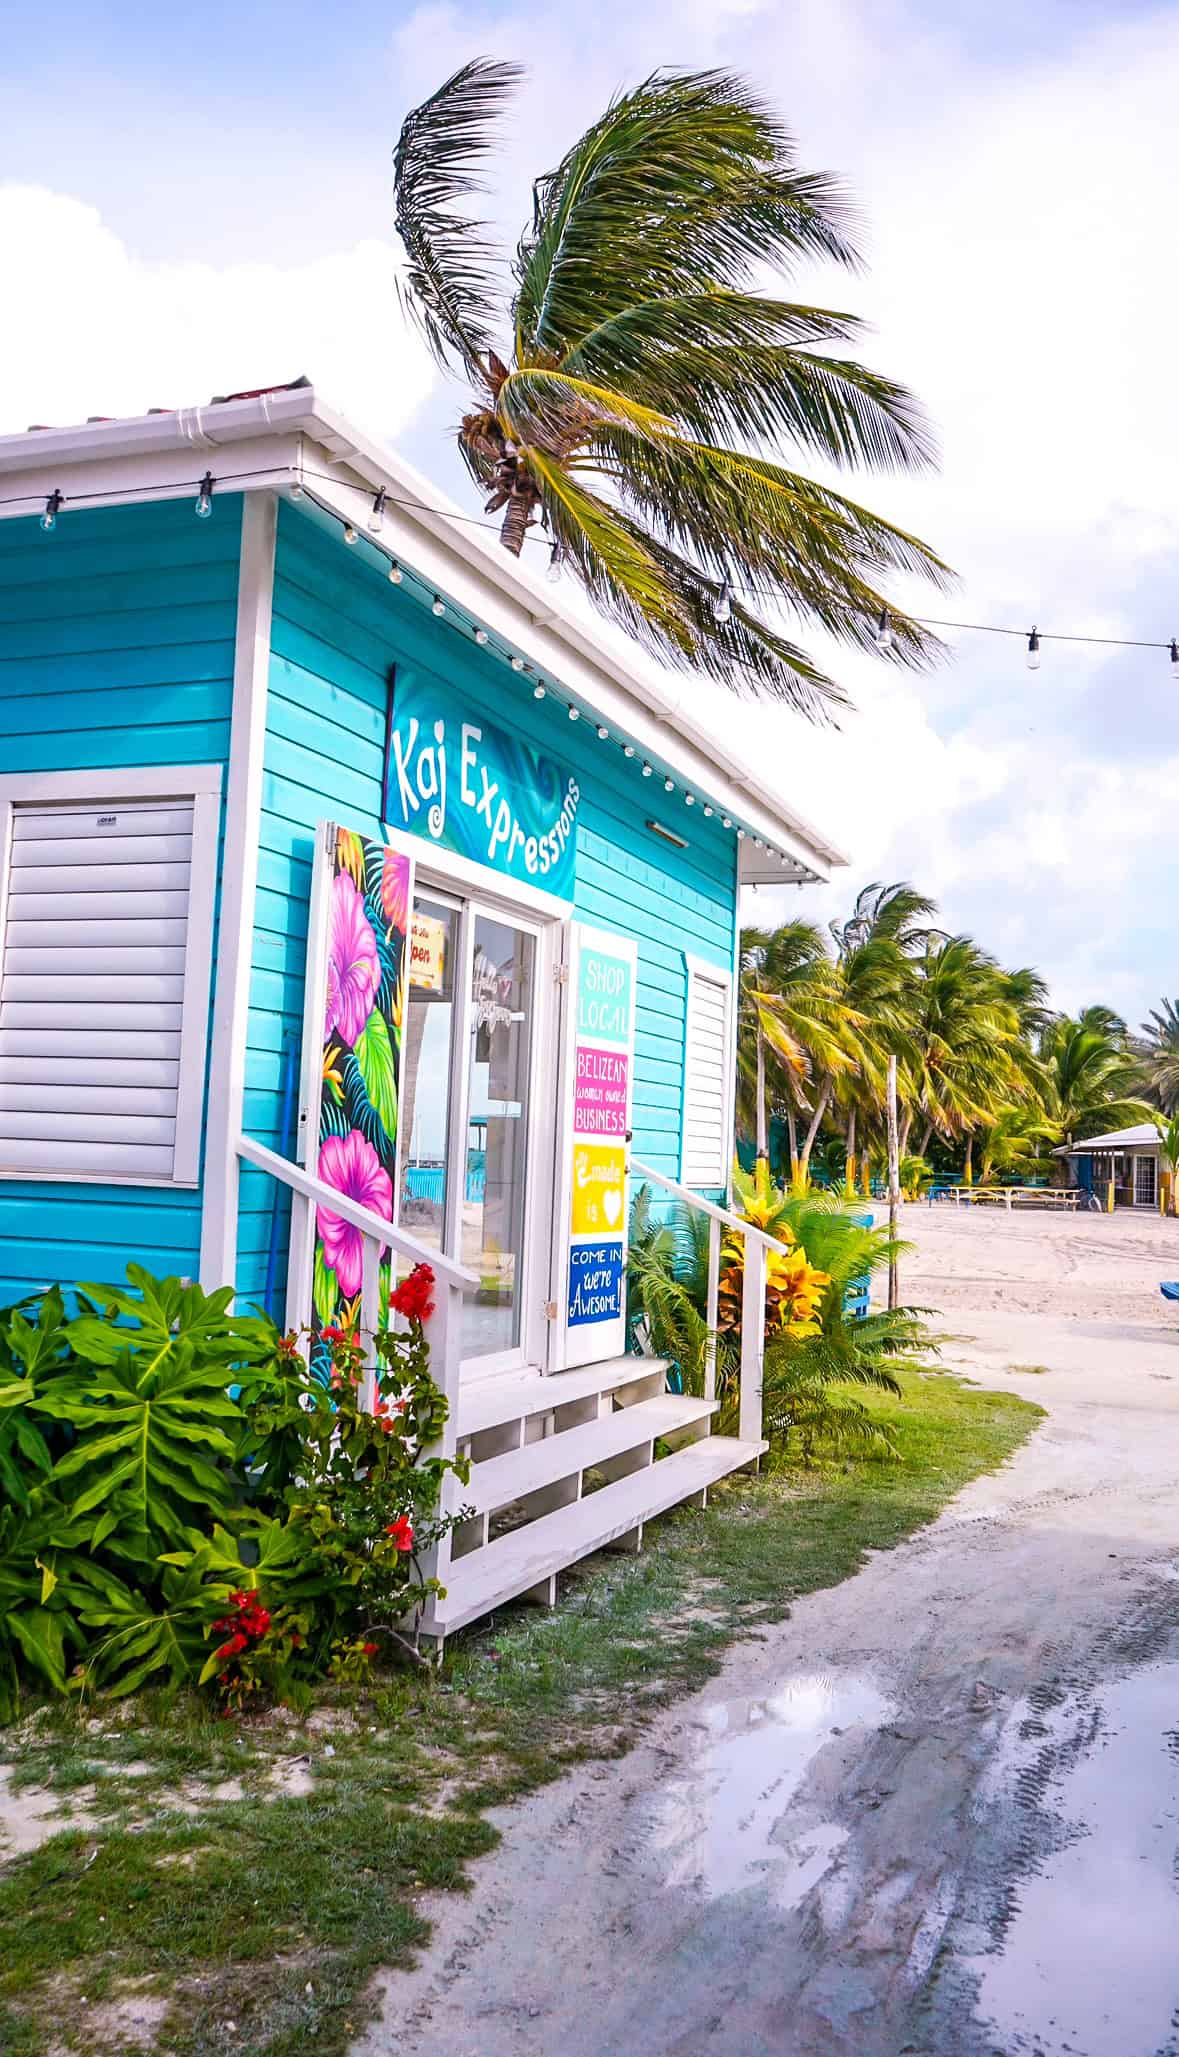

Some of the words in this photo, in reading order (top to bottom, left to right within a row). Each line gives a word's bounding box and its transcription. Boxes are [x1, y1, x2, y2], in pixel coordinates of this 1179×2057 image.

[393, 718, 446, 838] Kaj
[461, 723, 580, 874] Expressions
[411, 939, 430, 964] pen
[585, 960, 625, 997] SHOP
[579, 998, 629, 1036] LOCAL
[577, 1053, 627, 1083] BELIZEAN
[576, 1107, 625, 1131] BUSINESS
[571, 1249, 607, 1265] COME
[609, 1247, 622, 1262] IN
